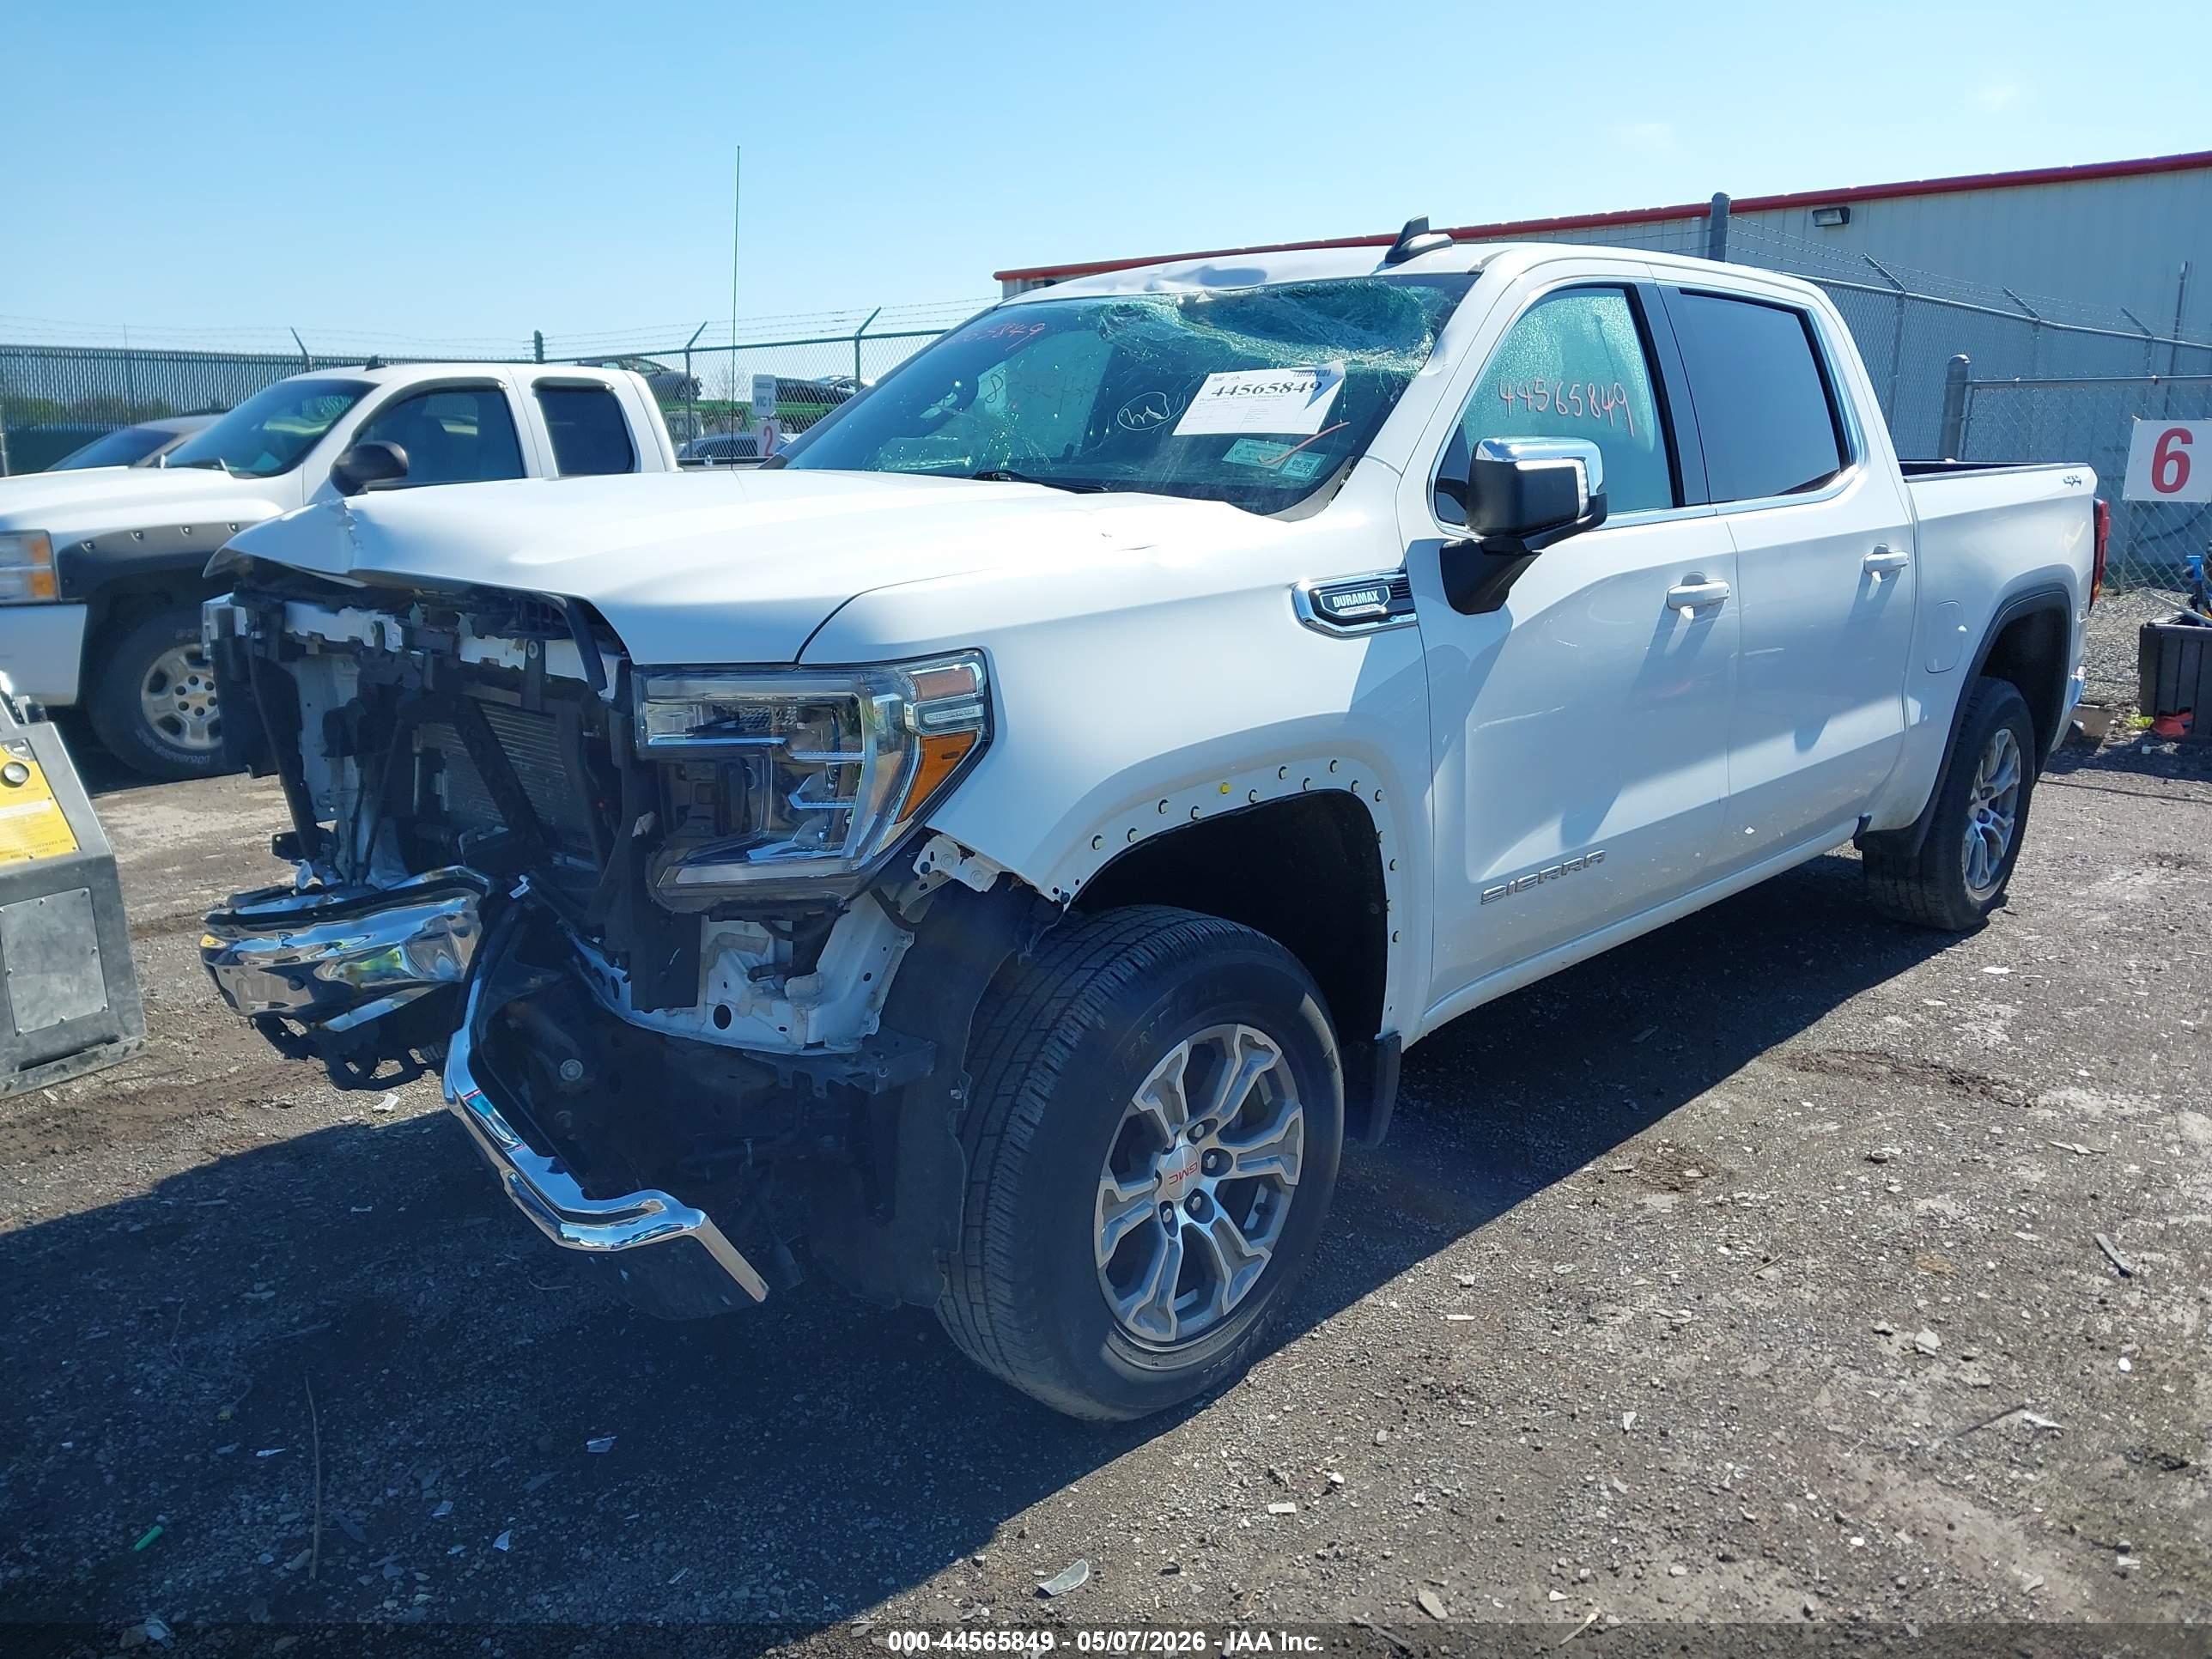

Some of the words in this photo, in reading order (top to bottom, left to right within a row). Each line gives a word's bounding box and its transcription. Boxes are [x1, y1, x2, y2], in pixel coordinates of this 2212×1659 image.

[1211, 381, 1322, 396] 44565849
[1498, 380, 1634, 437] 44565849
[763, 425, 774, 456] 2
[2152, 428, 2193, 494] 6
[1332, 590, 1380, 608] DURAMAX
[1480, 849, 1607, 905] SIERRA
[1168, 1161, 1198, 1186] GMC
